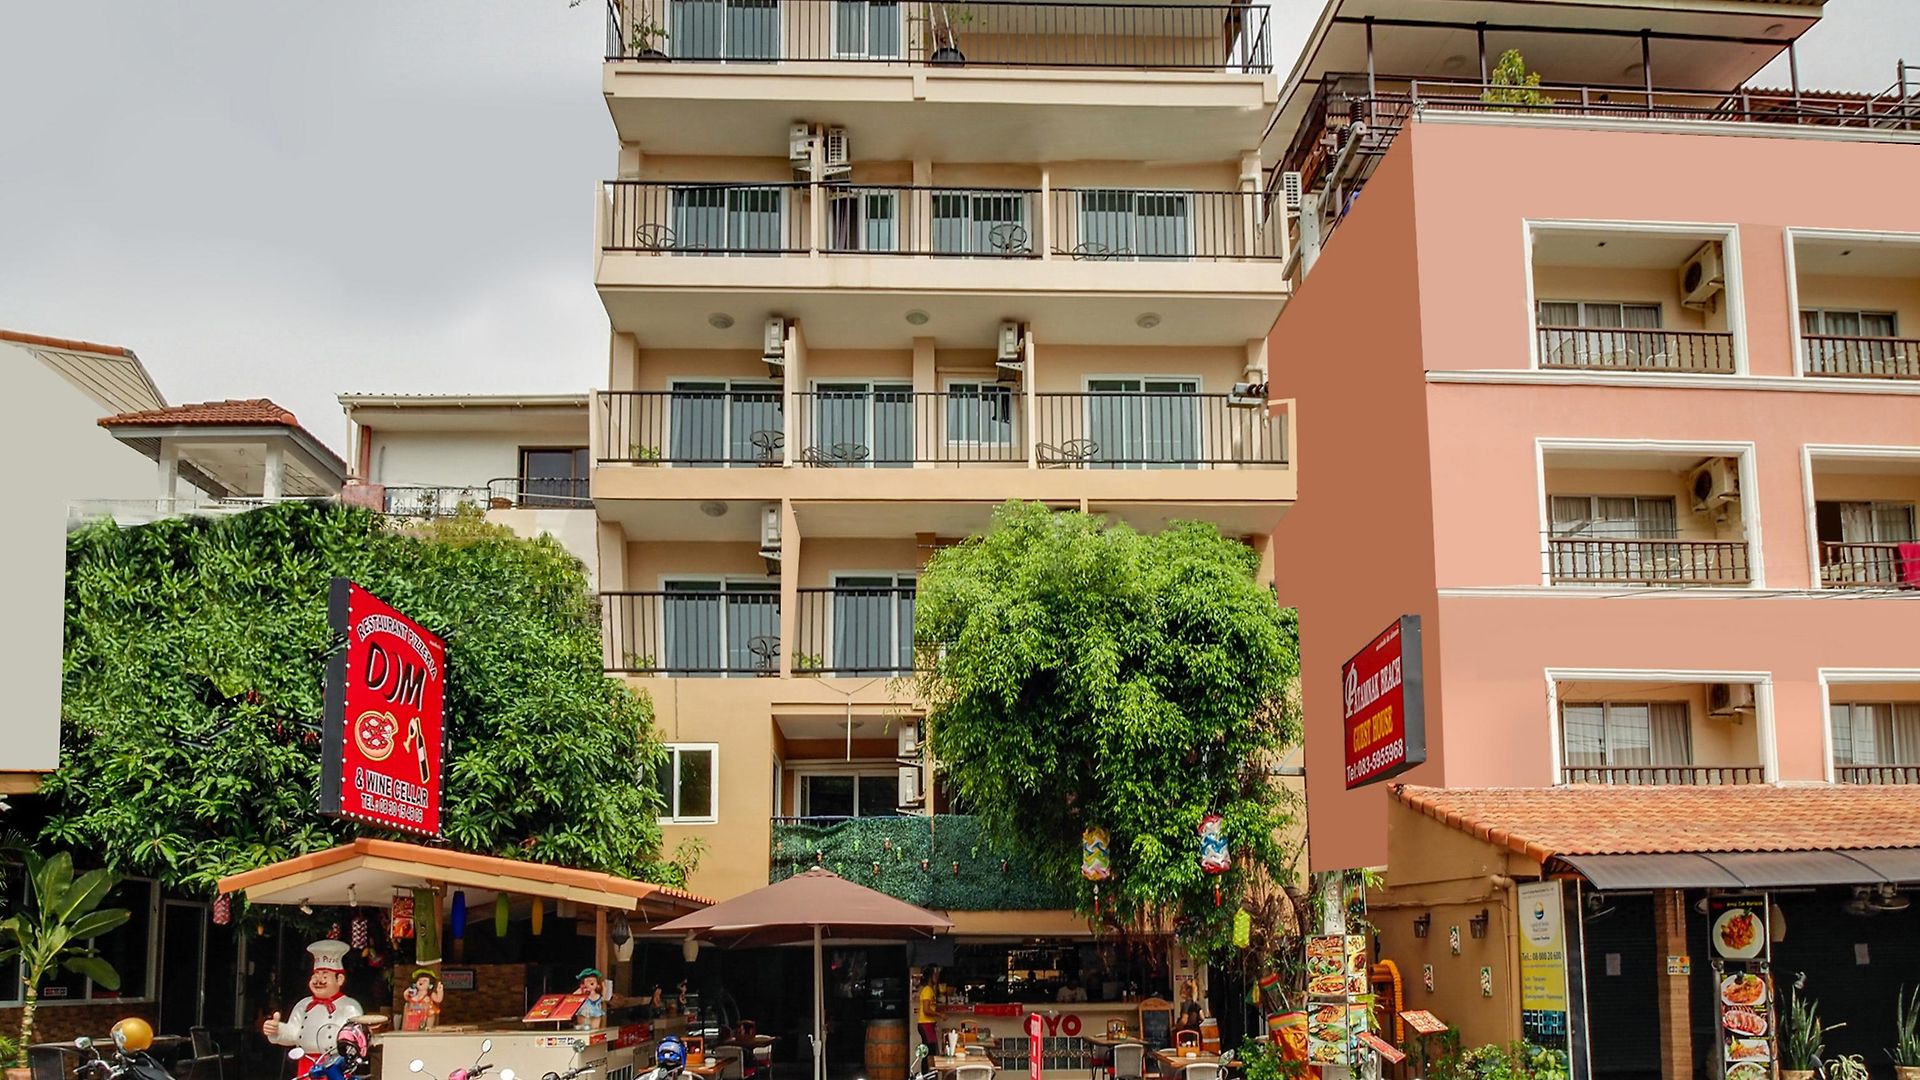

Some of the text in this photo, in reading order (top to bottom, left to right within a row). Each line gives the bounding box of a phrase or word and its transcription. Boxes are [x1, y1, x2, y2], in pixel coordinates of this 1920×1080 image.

[357, 614, 438, 681] RESTAURANT PIZZERIA
[365, 641, 427, 711] DJM
[1380, 656, 1402, 696] BEACH
[1353, 704, 1394, 753] GUEST HOUSE
[356, 766, 428, 808] & WINE CELLAR
